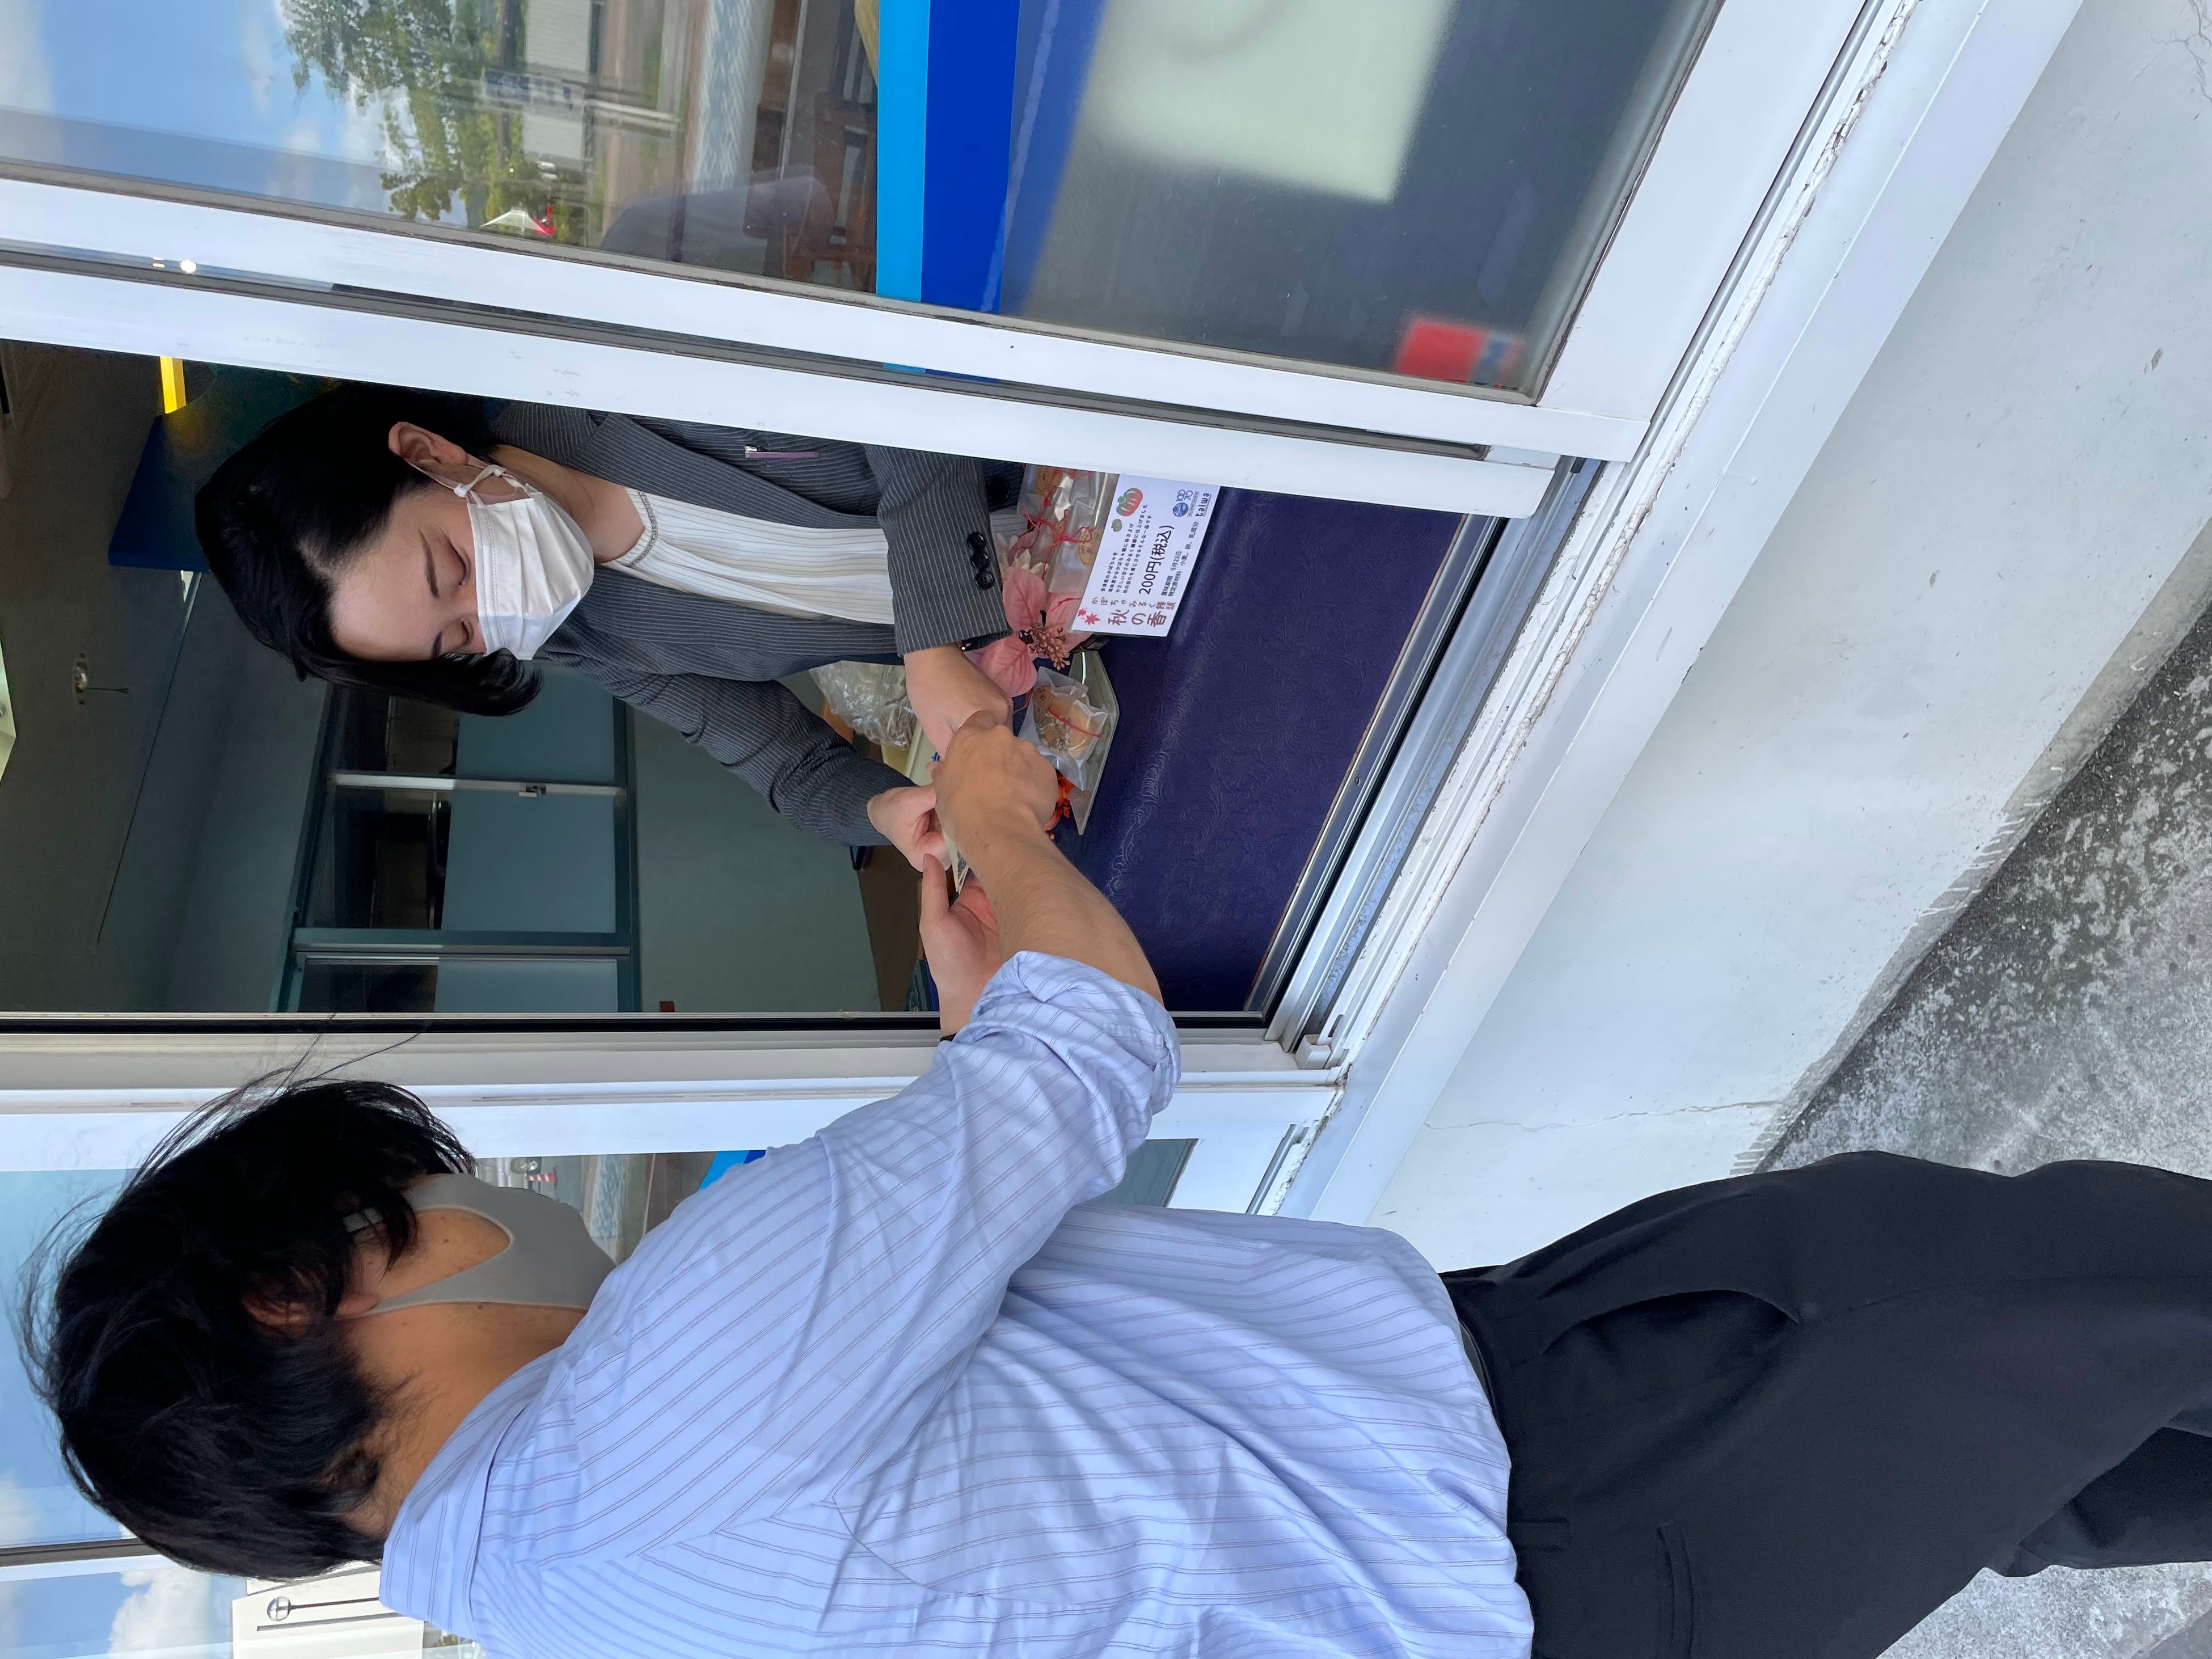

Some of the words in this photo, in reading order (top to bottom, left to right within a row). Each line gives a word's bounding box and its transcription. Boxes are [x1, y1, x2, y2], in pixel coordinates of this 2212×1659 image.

[1194, 492, 1210, 517] taiwa
[1138, 525, 1175, 595] 200円(税込)
[1160, 575, 1173, 596] 賞味期限
[1170, 551, 1182, 571] 9月23日
[1167, 571, 1182, 597] 特定原材料
[1107, 609, 1167, 627] 秋の香
